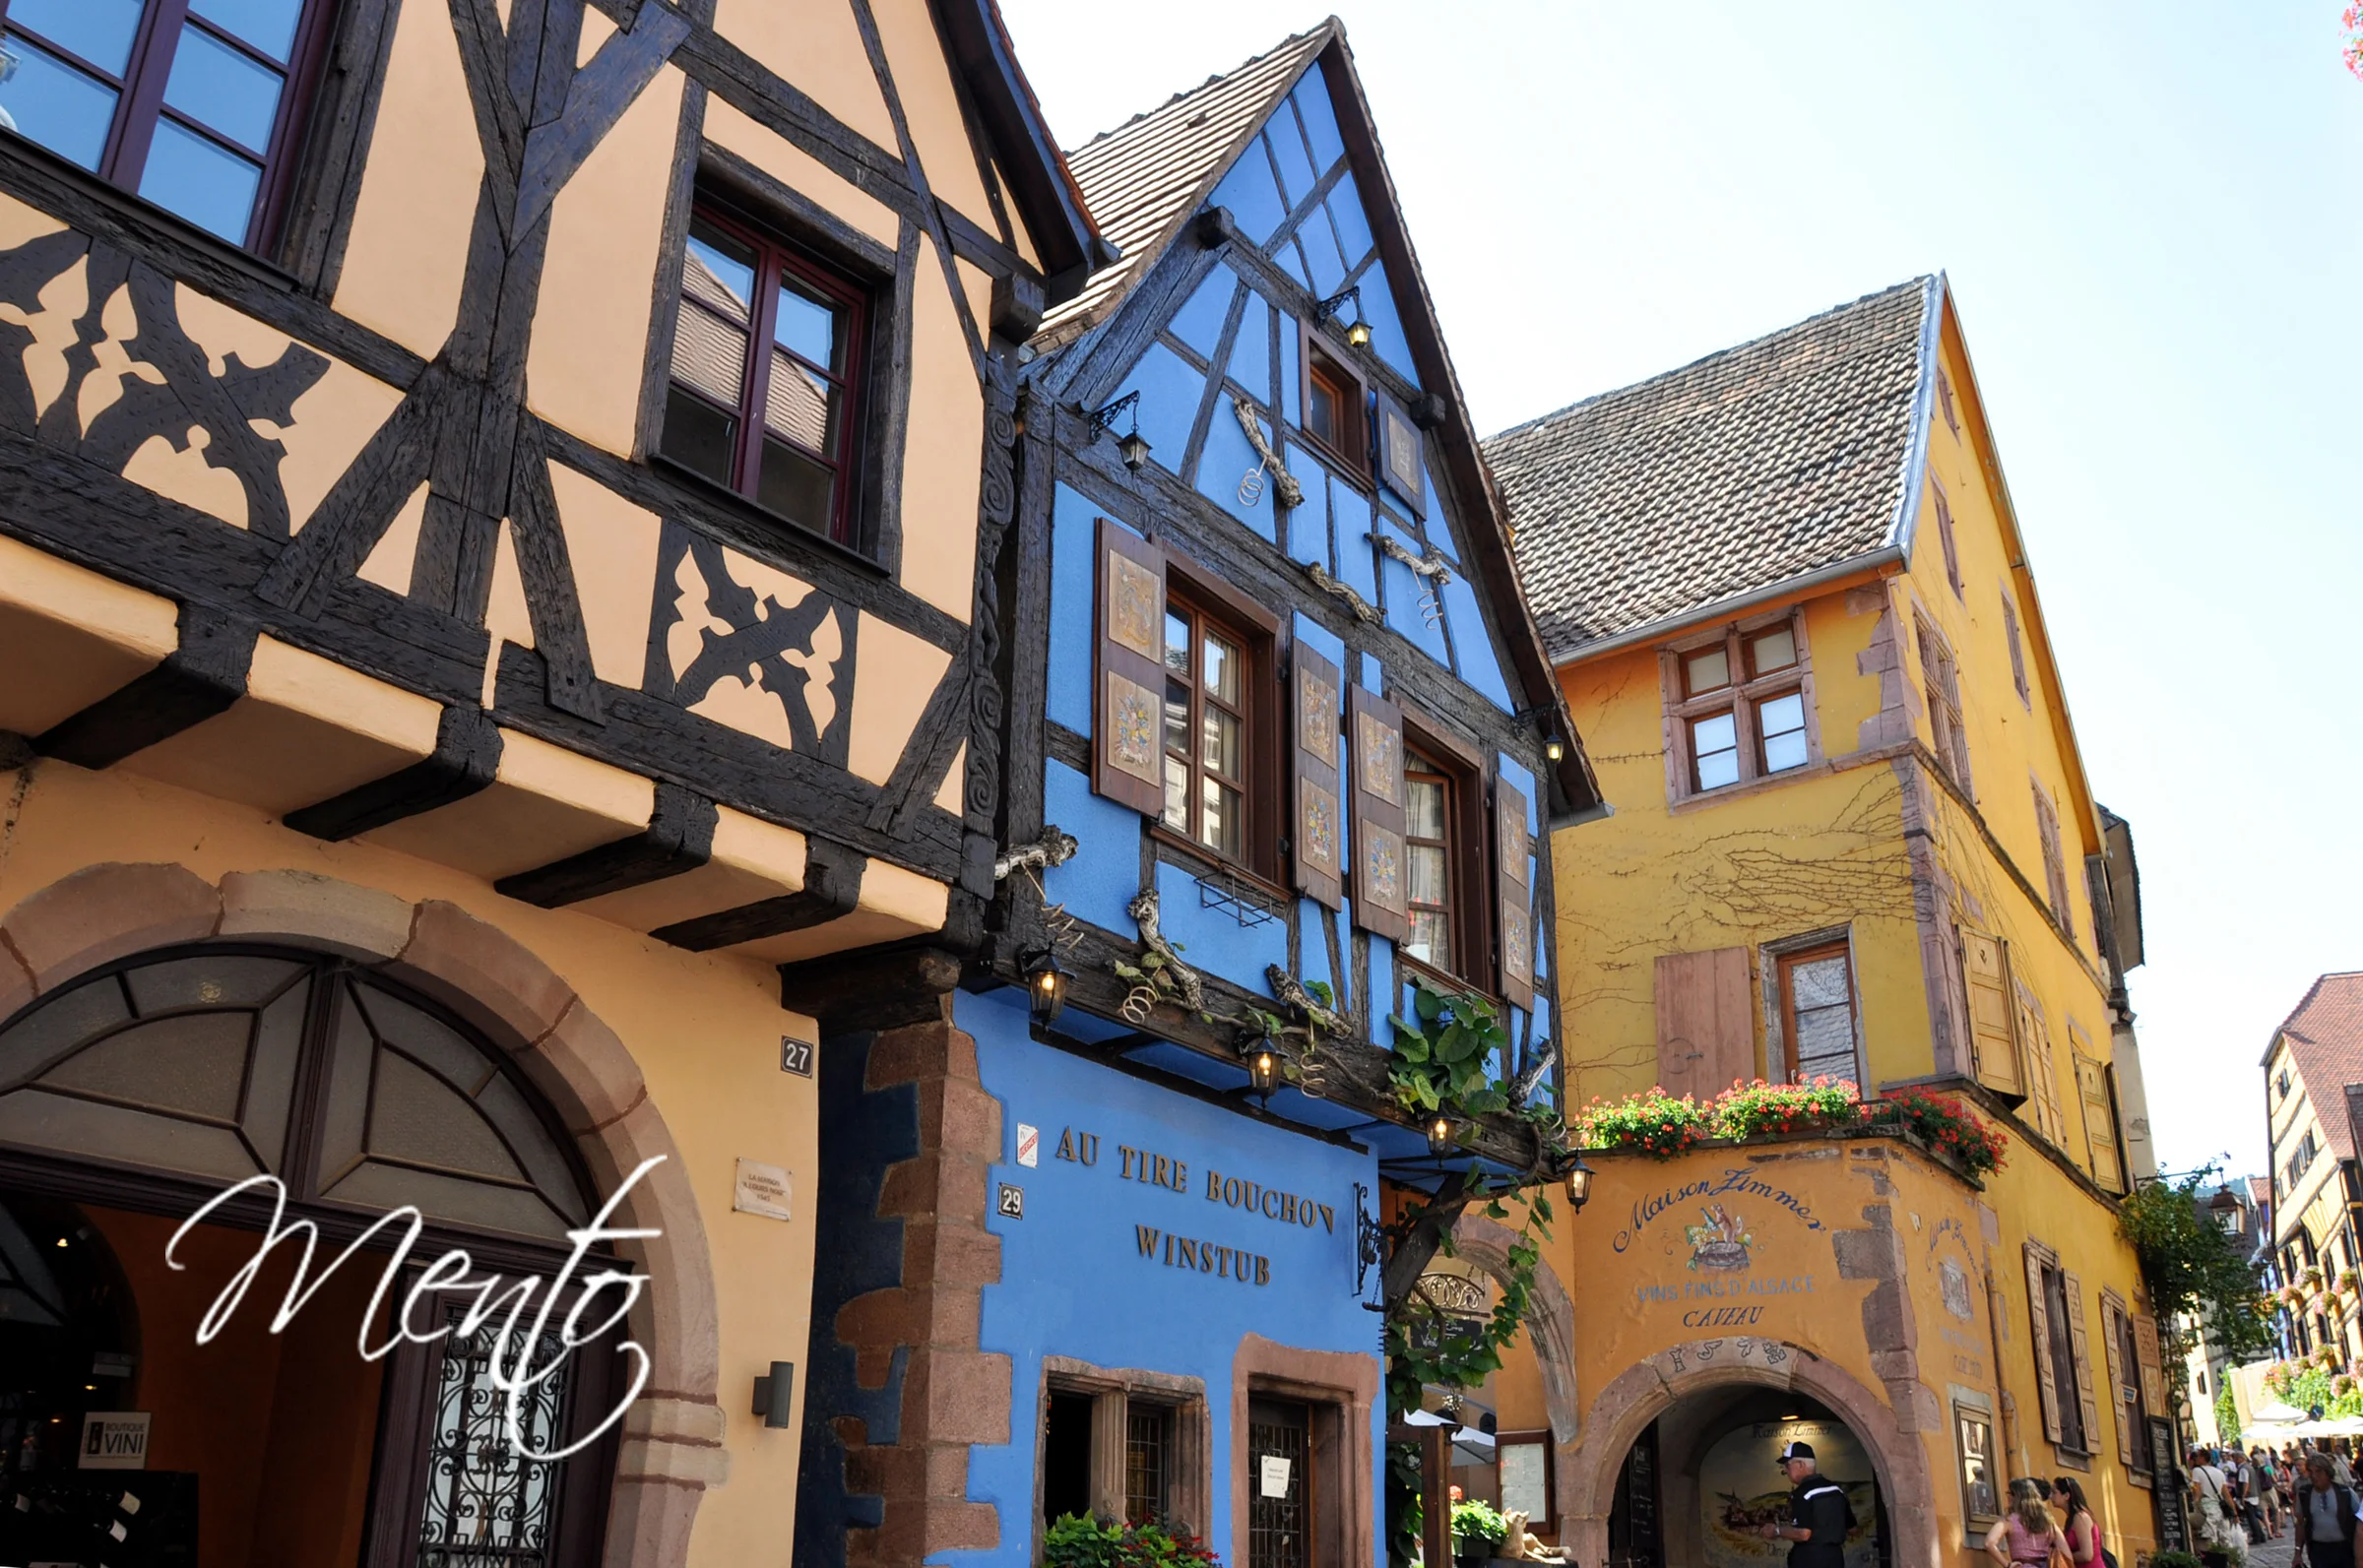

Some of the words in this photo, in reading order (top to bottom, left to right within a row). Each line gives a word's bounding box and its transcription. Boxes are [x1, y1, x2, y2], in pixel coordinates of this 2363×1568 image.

[786, 1043, 808, 1070] 27
[1055, 1126, 1101, 1165] AU
[1118, 1145, 1187, 1193] TIRE
[1205, 1169, 1335, 1235] BOUCHON
[1002, 1189, 1021, 1214] 29
[1613, 1180, 1710, 1253] Maison
[1708, 1167, 1826, 1232] Zimmer
[1135, 1223, 1270, 1286] WINSTUB
[1636, 1284, 1679, 1302] VINS
[1685, 1281, 1724, 1299] FINS
[1683, 1306, 1764, 1328] CAVEAU
[104, 1433, 145, 1454] VINI
